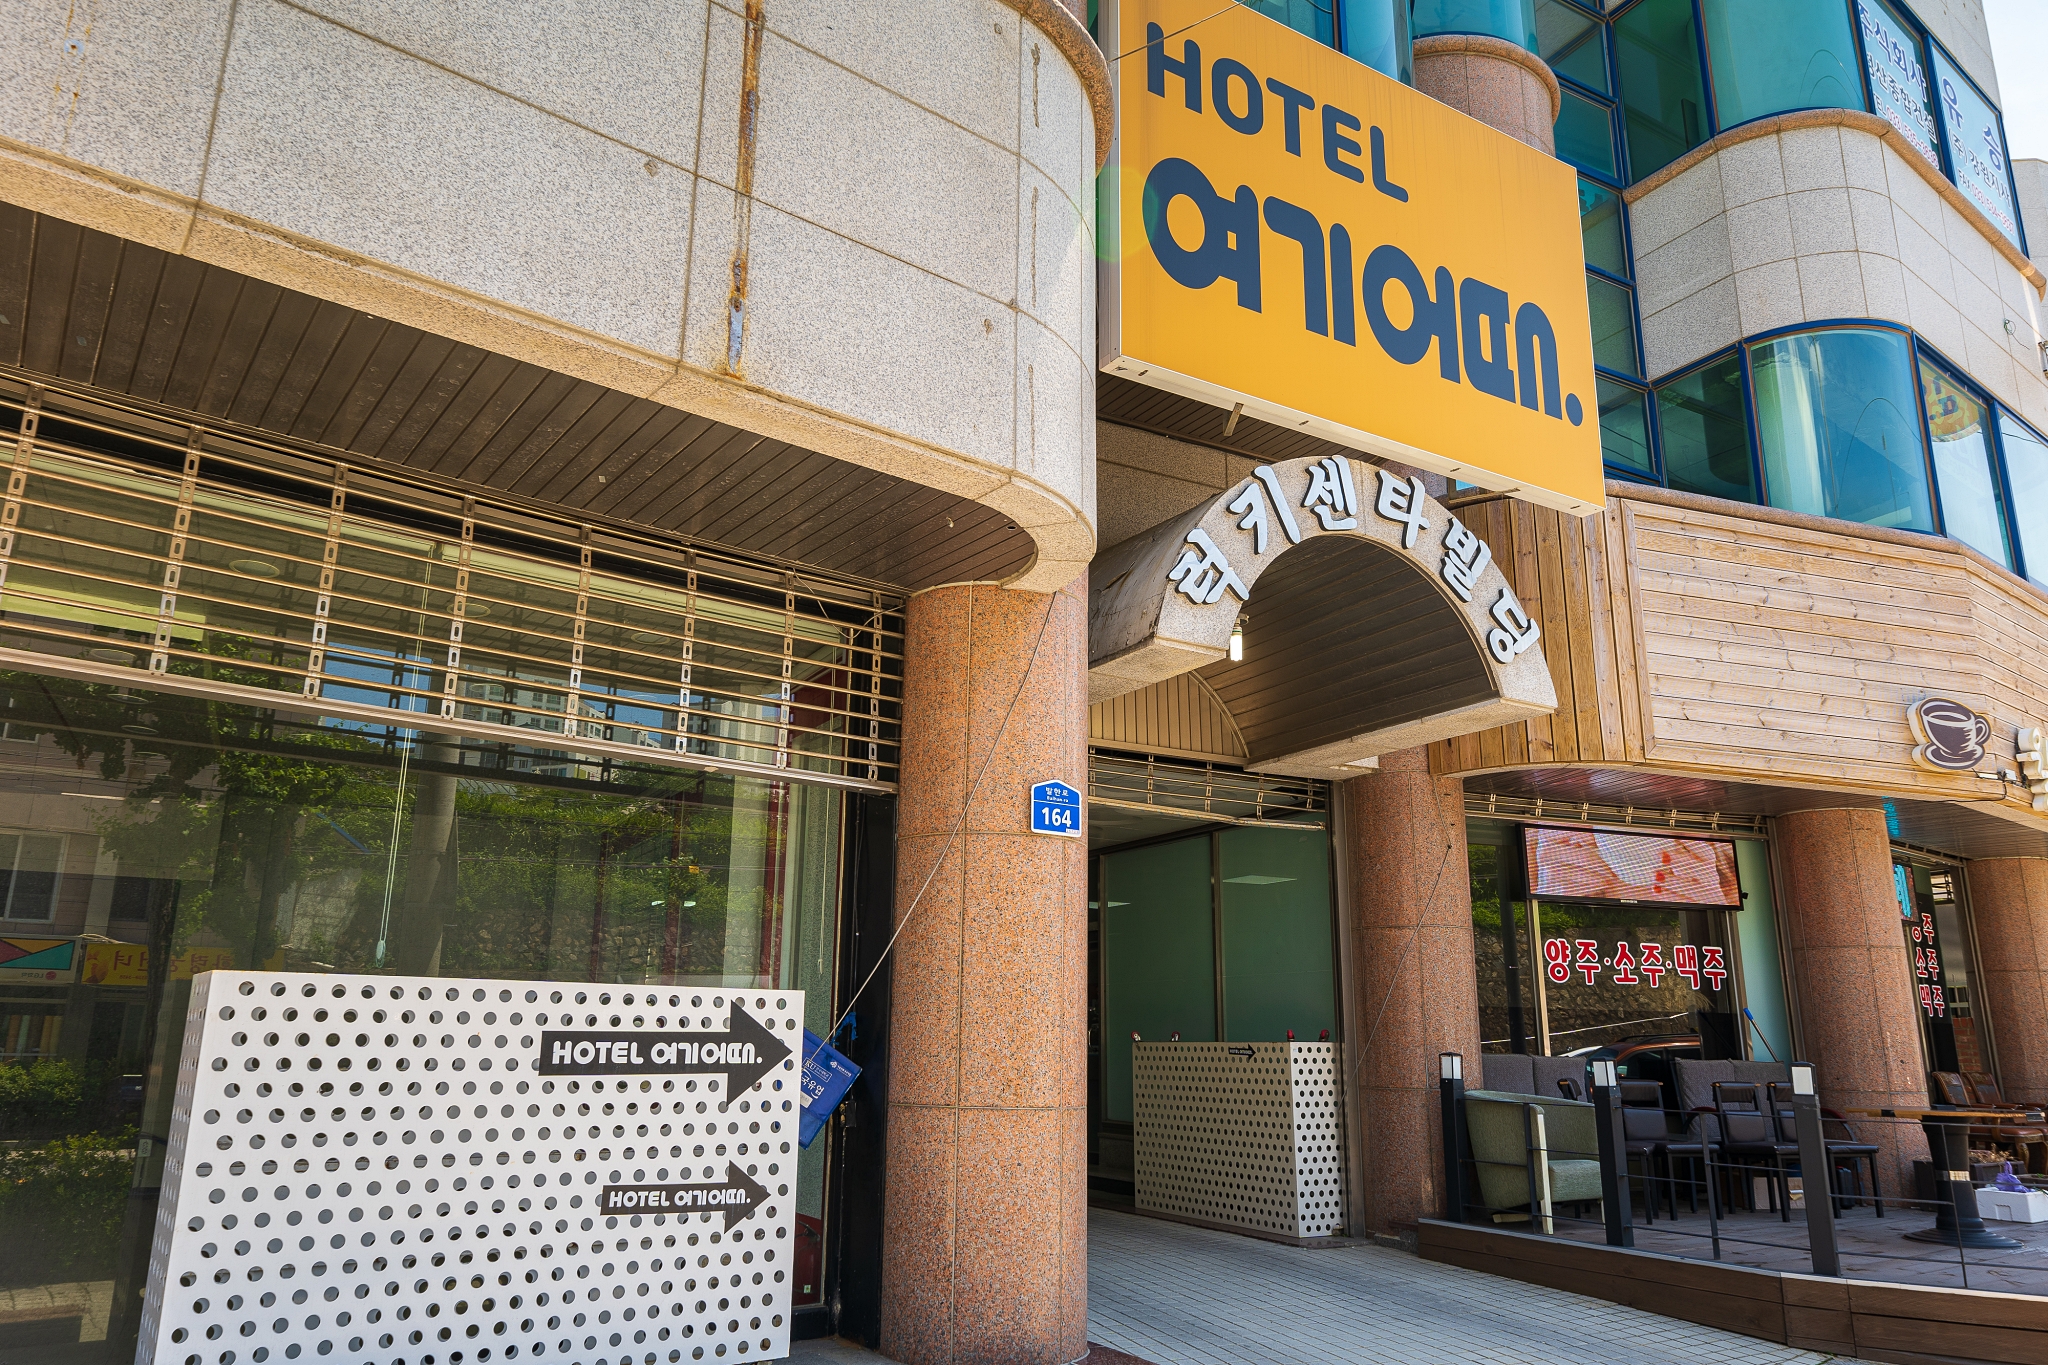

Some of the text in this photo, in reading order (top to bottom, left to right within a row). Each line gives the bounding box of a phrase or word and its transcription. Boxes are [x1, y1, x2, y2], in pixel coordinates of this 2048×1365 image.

[1146, 21, 1410, 203] HOTEL
[1041, 806, 1072, 828] 164
[551, 1040, 645, 1066] HOTEL
[608, 1190, 671, 1208] HOTEL
